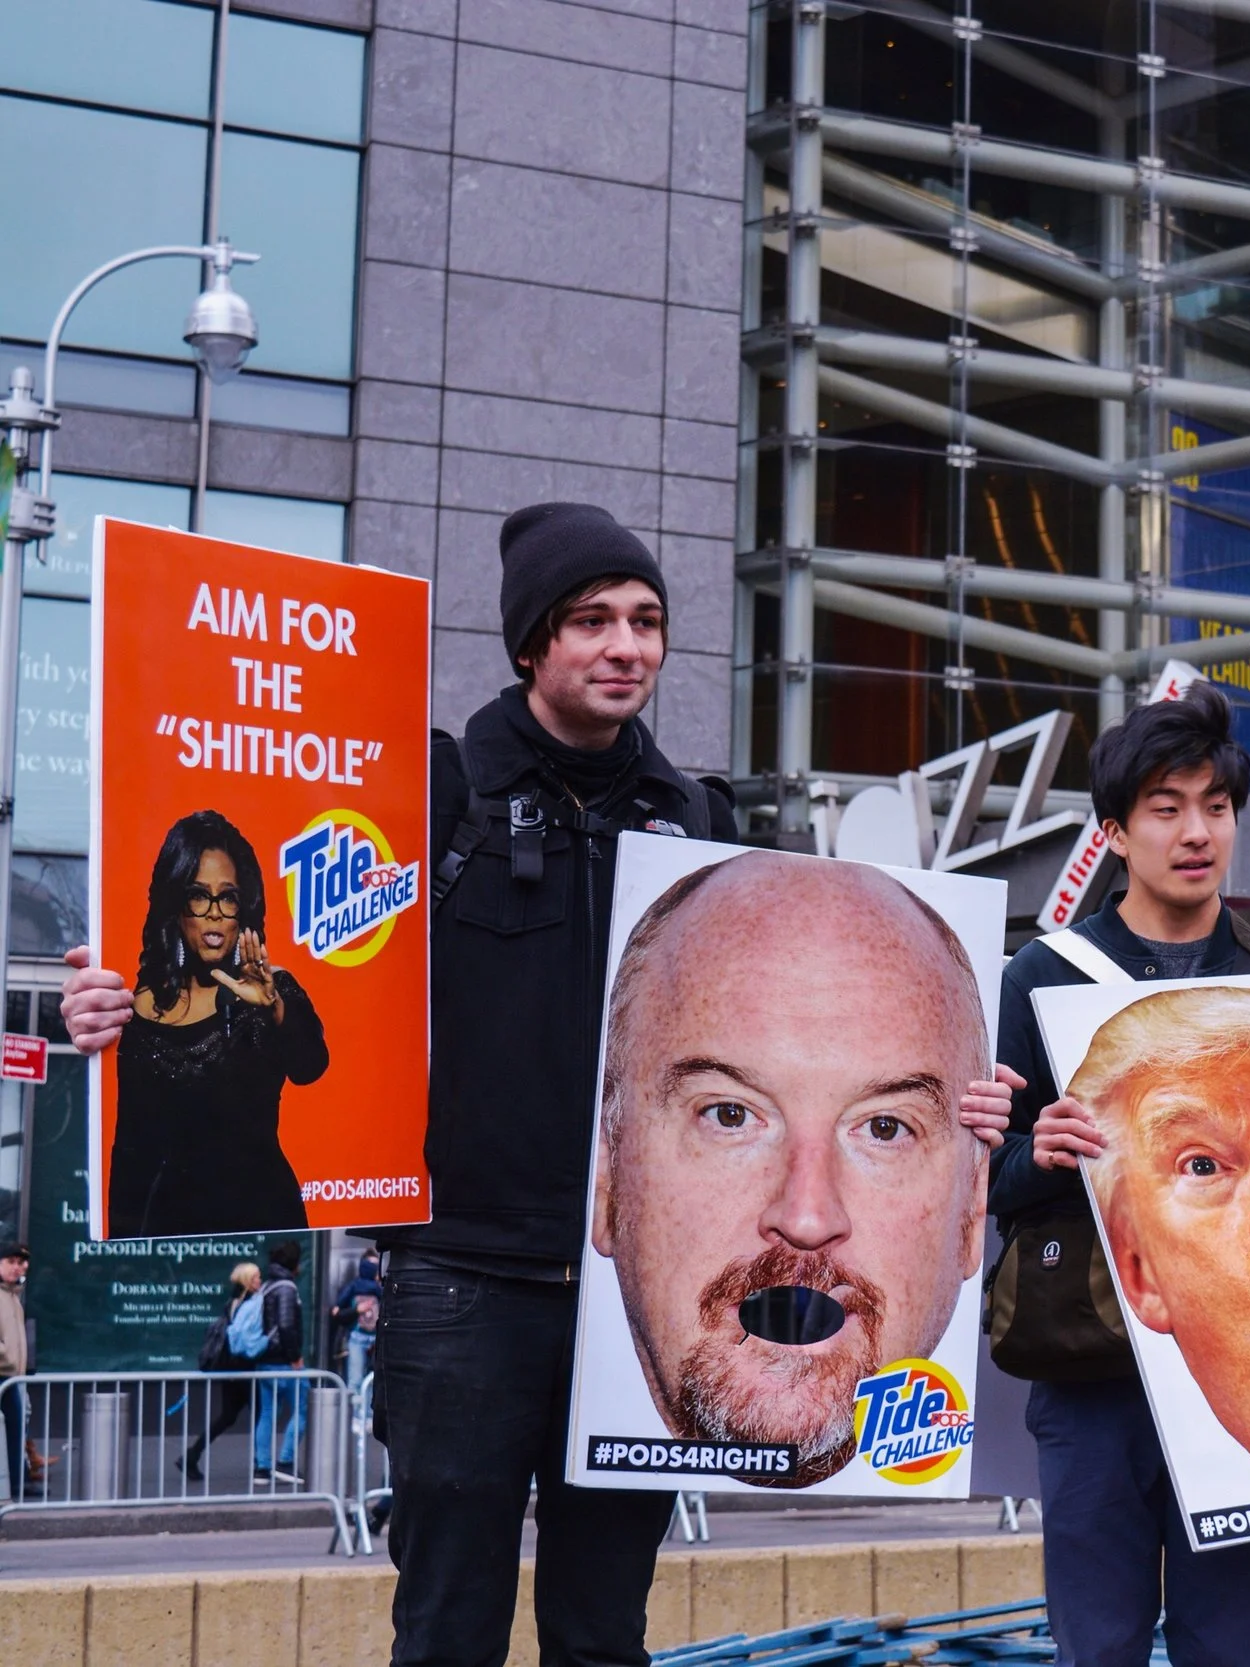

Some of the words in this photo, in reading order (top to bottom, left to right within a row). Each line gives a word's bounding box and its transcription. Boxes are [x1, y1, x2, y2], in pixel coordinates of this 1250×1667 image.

[187, 583, 268, 642] AIM
[282, 599, 358, 656] FOR
[231, 657, 302, 713] THE
[284, 826, 372, 938] Tide
[1052, 889, 1075, 925] at
[313, 868, 414, 953] CHALLENGE
[301, 1177, 420, 1201] #PODS4RIGHTS
[74, 1239, 153, 1263] personal
[857, 1371, 945, 1453] Tide
[594, 1442, 790, 1472] #PODS4RIGHTS
